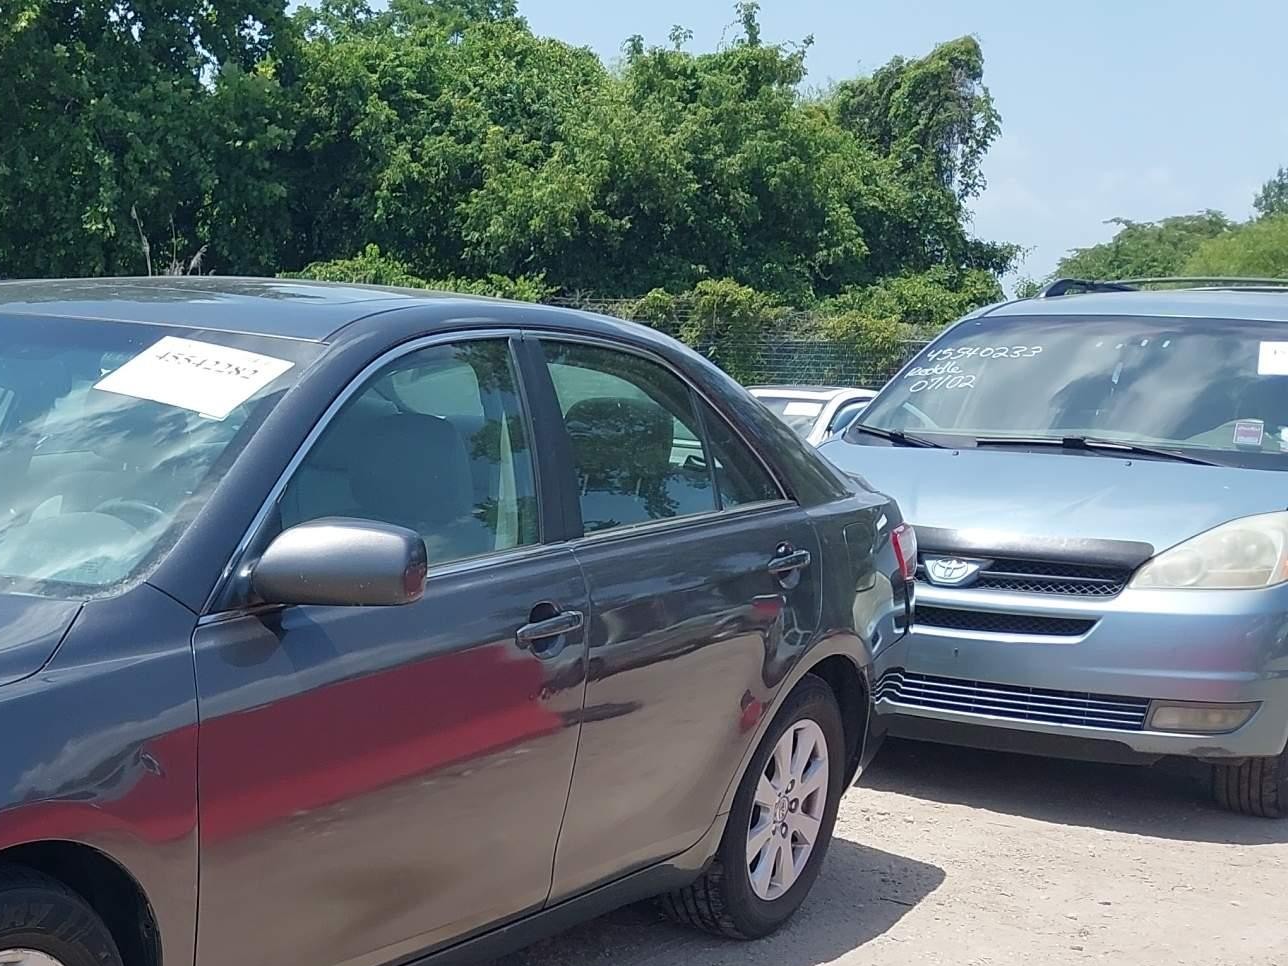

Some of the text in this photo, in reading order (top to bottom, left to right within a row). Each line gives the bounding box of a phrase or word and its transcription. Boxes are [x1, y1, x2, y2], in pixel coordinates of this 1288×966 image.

[927, 346, 1042, 361] 45540233
[156, 352, 258, 379] 45542282
[909, 375, 976, 392] 07/02
